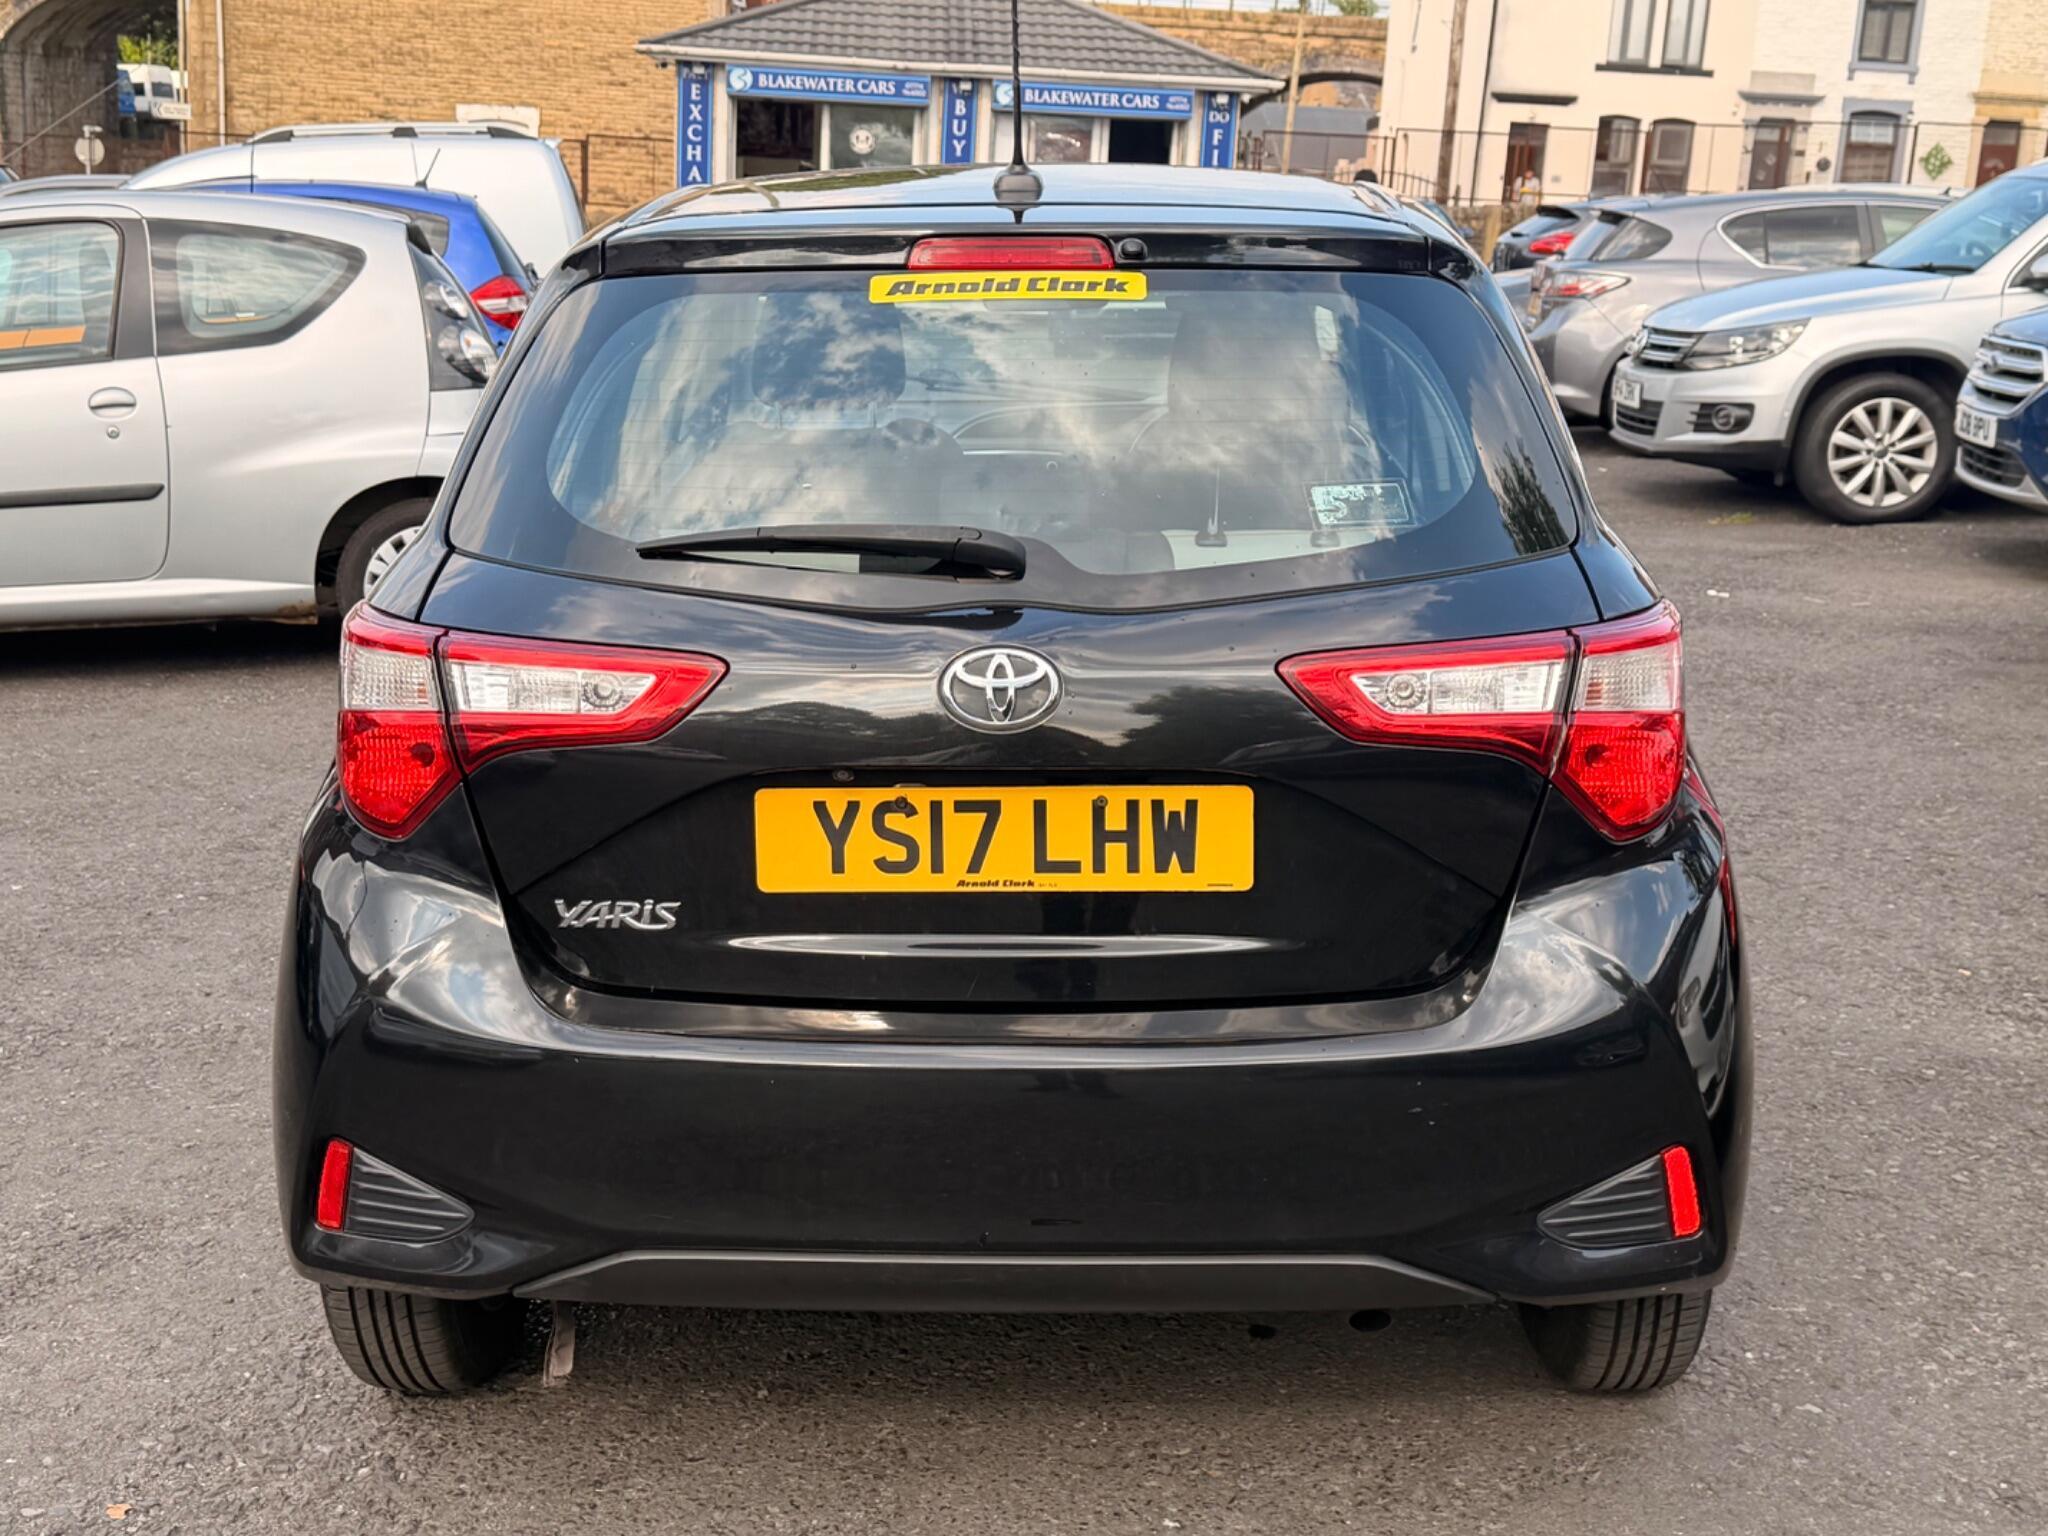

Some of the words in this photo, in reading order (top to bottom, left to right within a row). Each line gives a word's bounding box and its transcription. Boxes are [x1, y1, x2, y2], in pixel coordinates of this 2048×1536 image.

[758, 73, 855, 93] BLAKEWATER
[857, 79, 896, 95] CARS
[1024, 88, 1121, 107] BLAKEWATER
[1122, 93, 1160, 109] CARS
[952, 98, 967, 157] BUY
[1209, 110, 1230, 124] DO
[885, 278, 1021, 296] Arnold
[1026, 277, 1129, 293] Clark
[812, 800, 1002, 875] YS17
[1033, 799, 1199, 874] LHW
[956, 879, 1000, 888] Arnold
[1002, 879, 1035, 887] Clark
